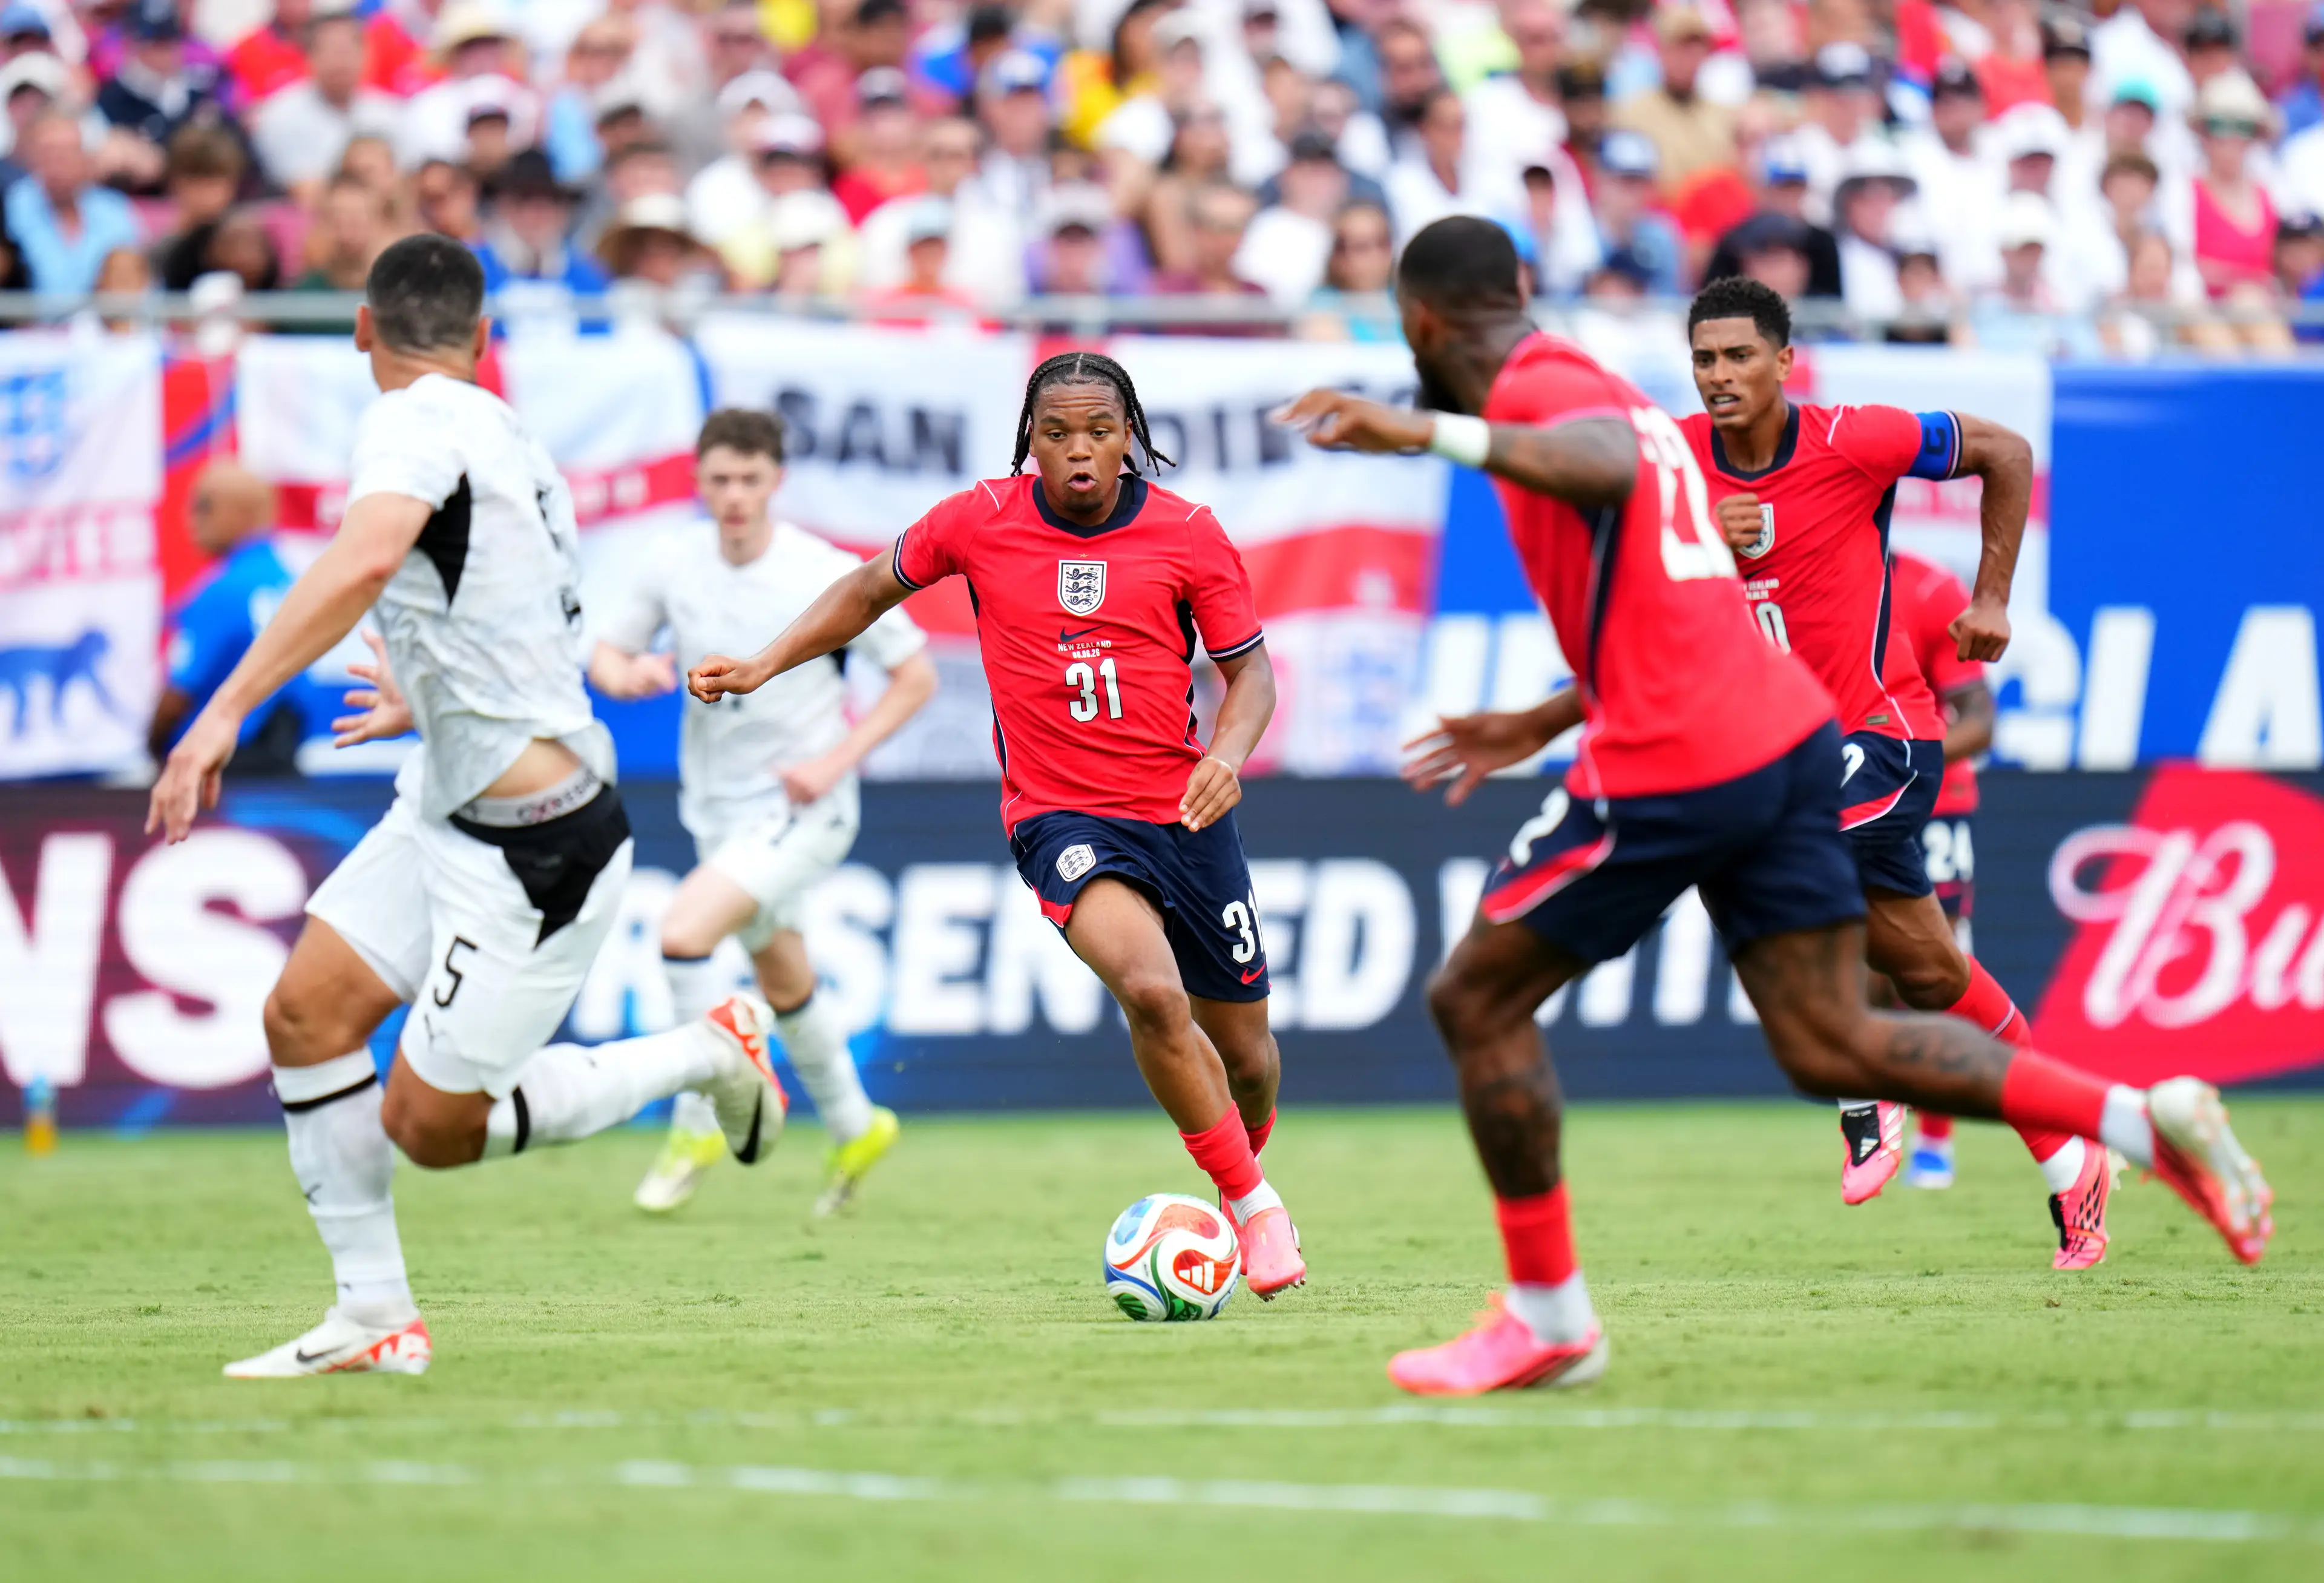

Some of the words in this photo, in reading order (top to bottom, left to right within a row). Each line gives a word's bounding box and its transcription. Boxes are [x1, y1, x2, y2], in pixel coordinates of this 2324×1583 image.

[1058, 643, 1074, 652] NEW
[1076, 640, 1112, 650] ZEALAND
[1747, 601, 1791, 655] 0
[1065, 657, 1123, 722] 31
[1222, 889, 1264, 964] 31
[433, 935, 478, 1009] 5
